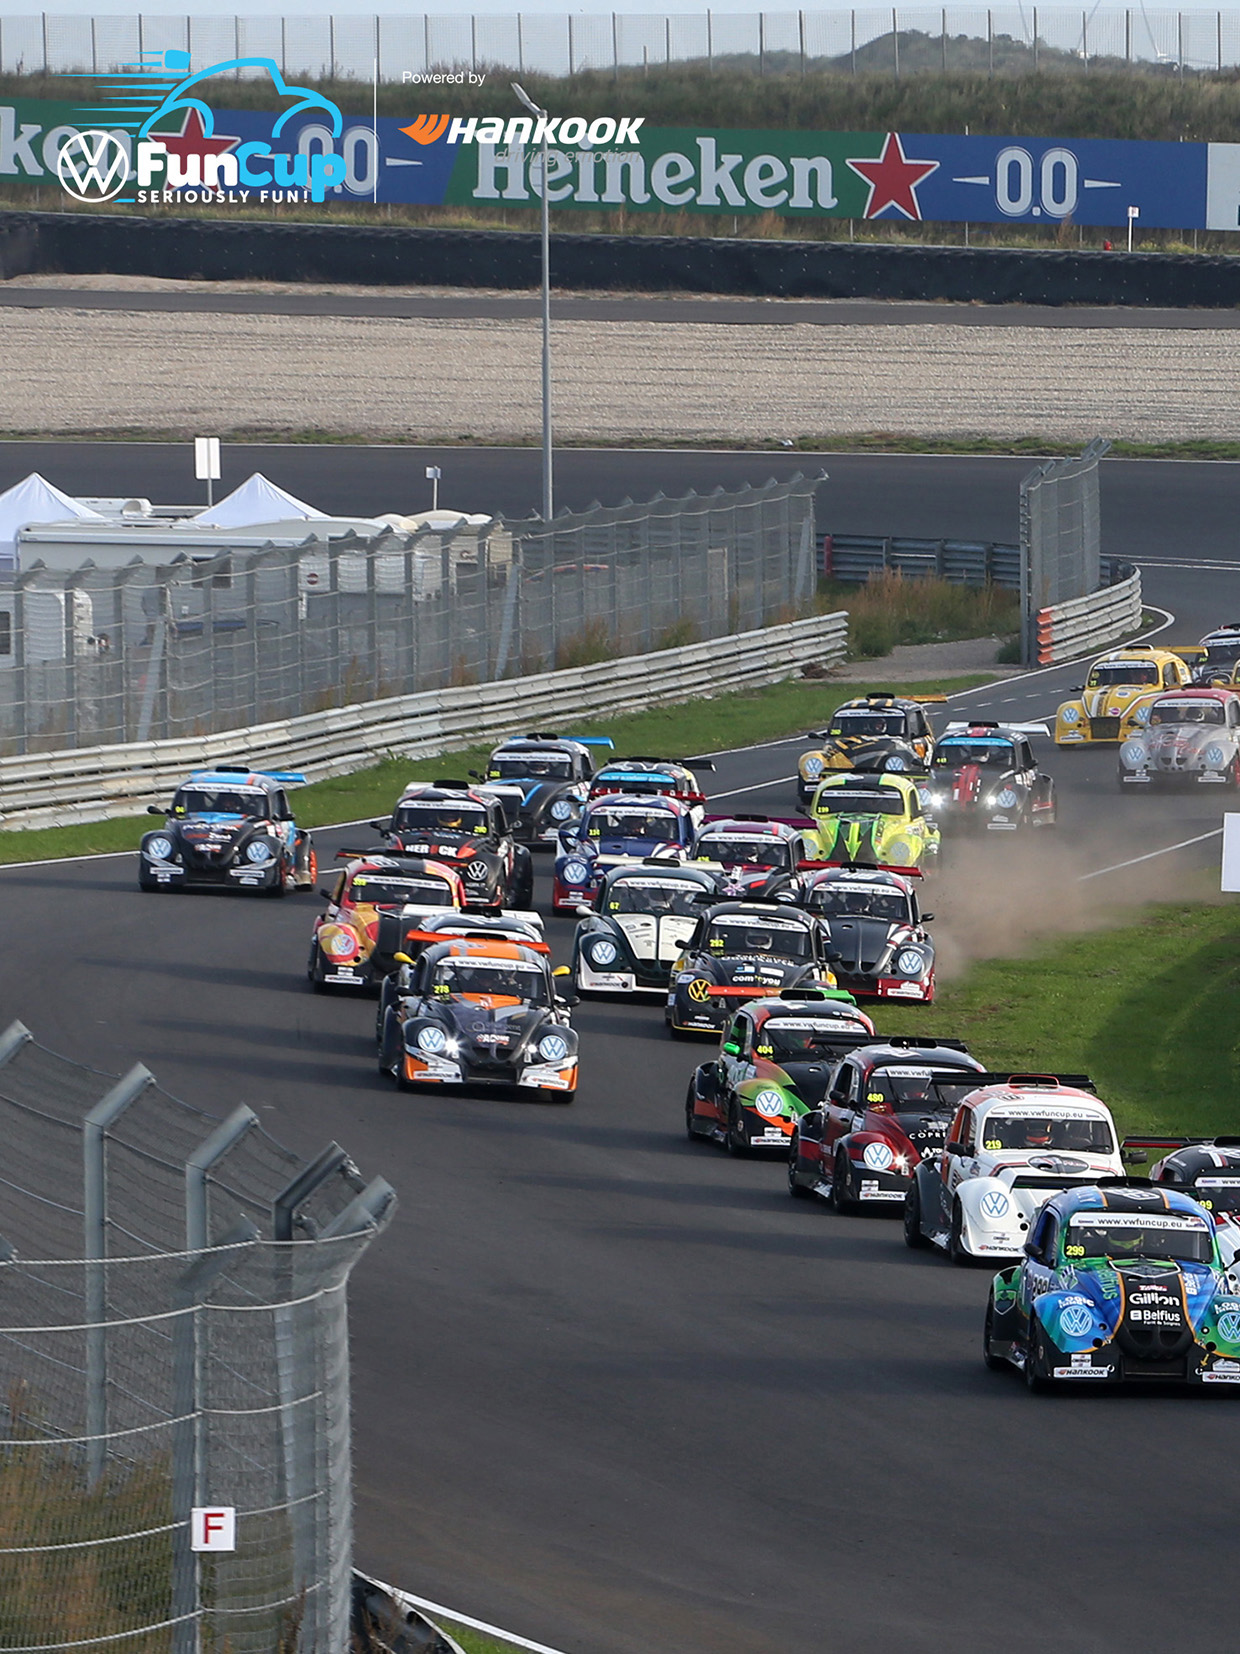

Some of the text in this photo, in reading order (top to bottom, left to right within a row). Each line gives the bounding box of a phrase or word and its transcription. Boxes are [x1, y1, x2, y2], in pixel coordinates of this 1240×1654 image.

[472, 129, 838, 210] Heineken
[993, 144, 1080, 218] 0.0
[985, 1139, 1002, 1150] 219
[1097, 1217, 1183, 1229] www.vwfuncup.eu
[1065, 1245, 1085, 1257] 299
[1143, 1309, 1181, 1322] Belfius
[203, 1512, 226, 1545] F
